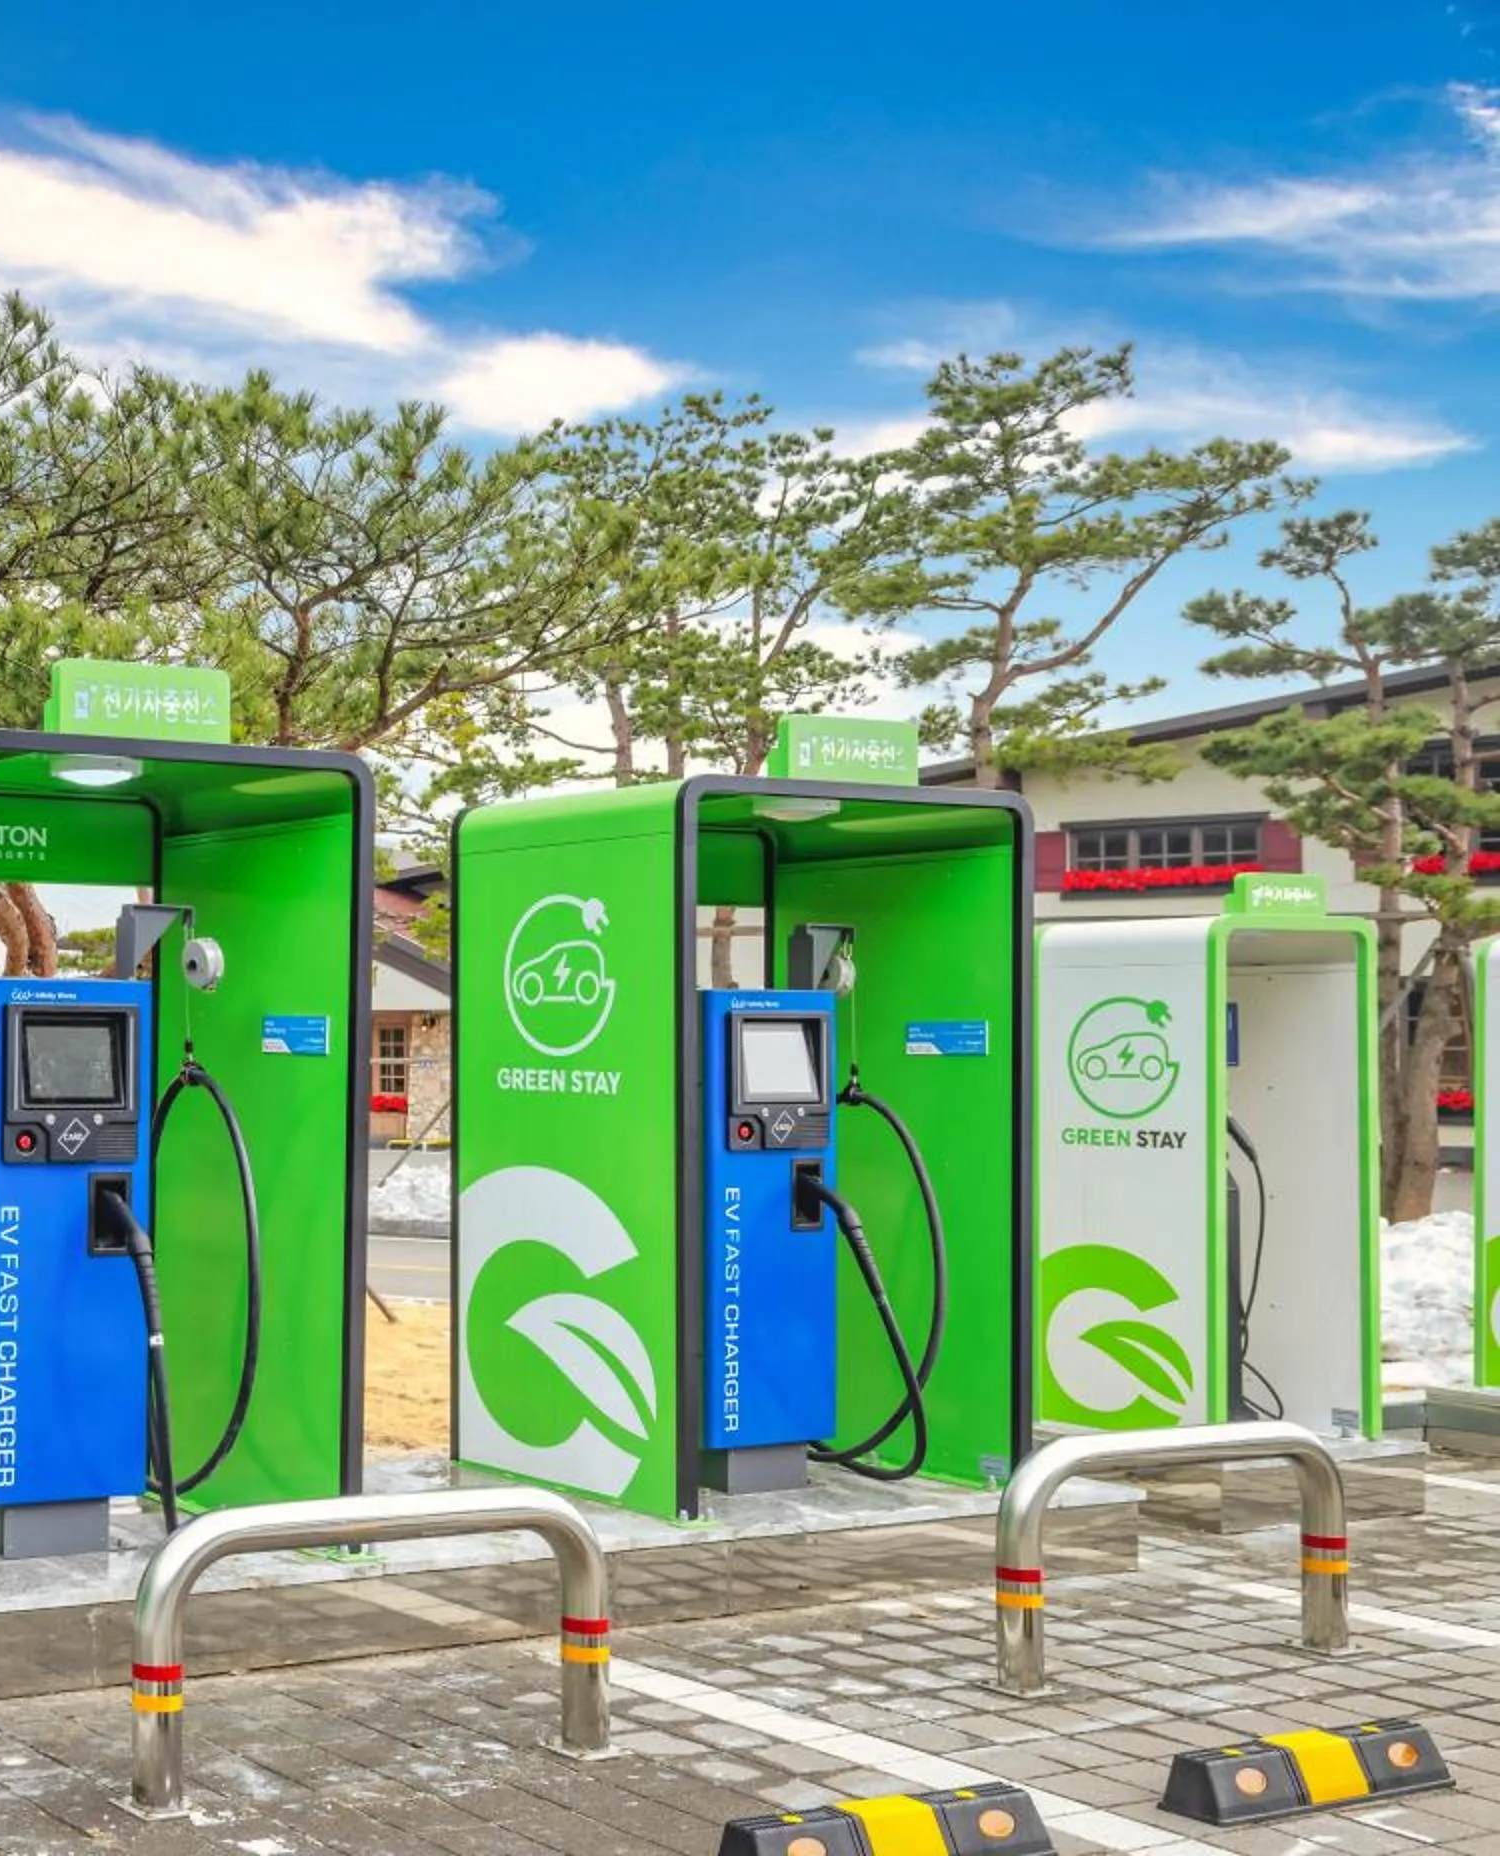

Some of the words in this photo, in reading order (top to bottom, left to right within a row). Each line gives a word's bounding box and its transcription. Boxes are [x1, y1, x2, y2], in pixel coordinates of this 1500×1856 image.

[497, 1067, 566, 1093] GREEN
[571, 1070, 622, 1096] STAY
[1061, 1127, 1132, 1148] GREEN
[1136, 1130, 1187, 1149] STAY
[724, 1187, 741, 1222] EV
[0, 1205, 20, 1245] EV
[724, 1228, 741, 1297] FAST
[723, 1303, 740, 1433] CHARGER
